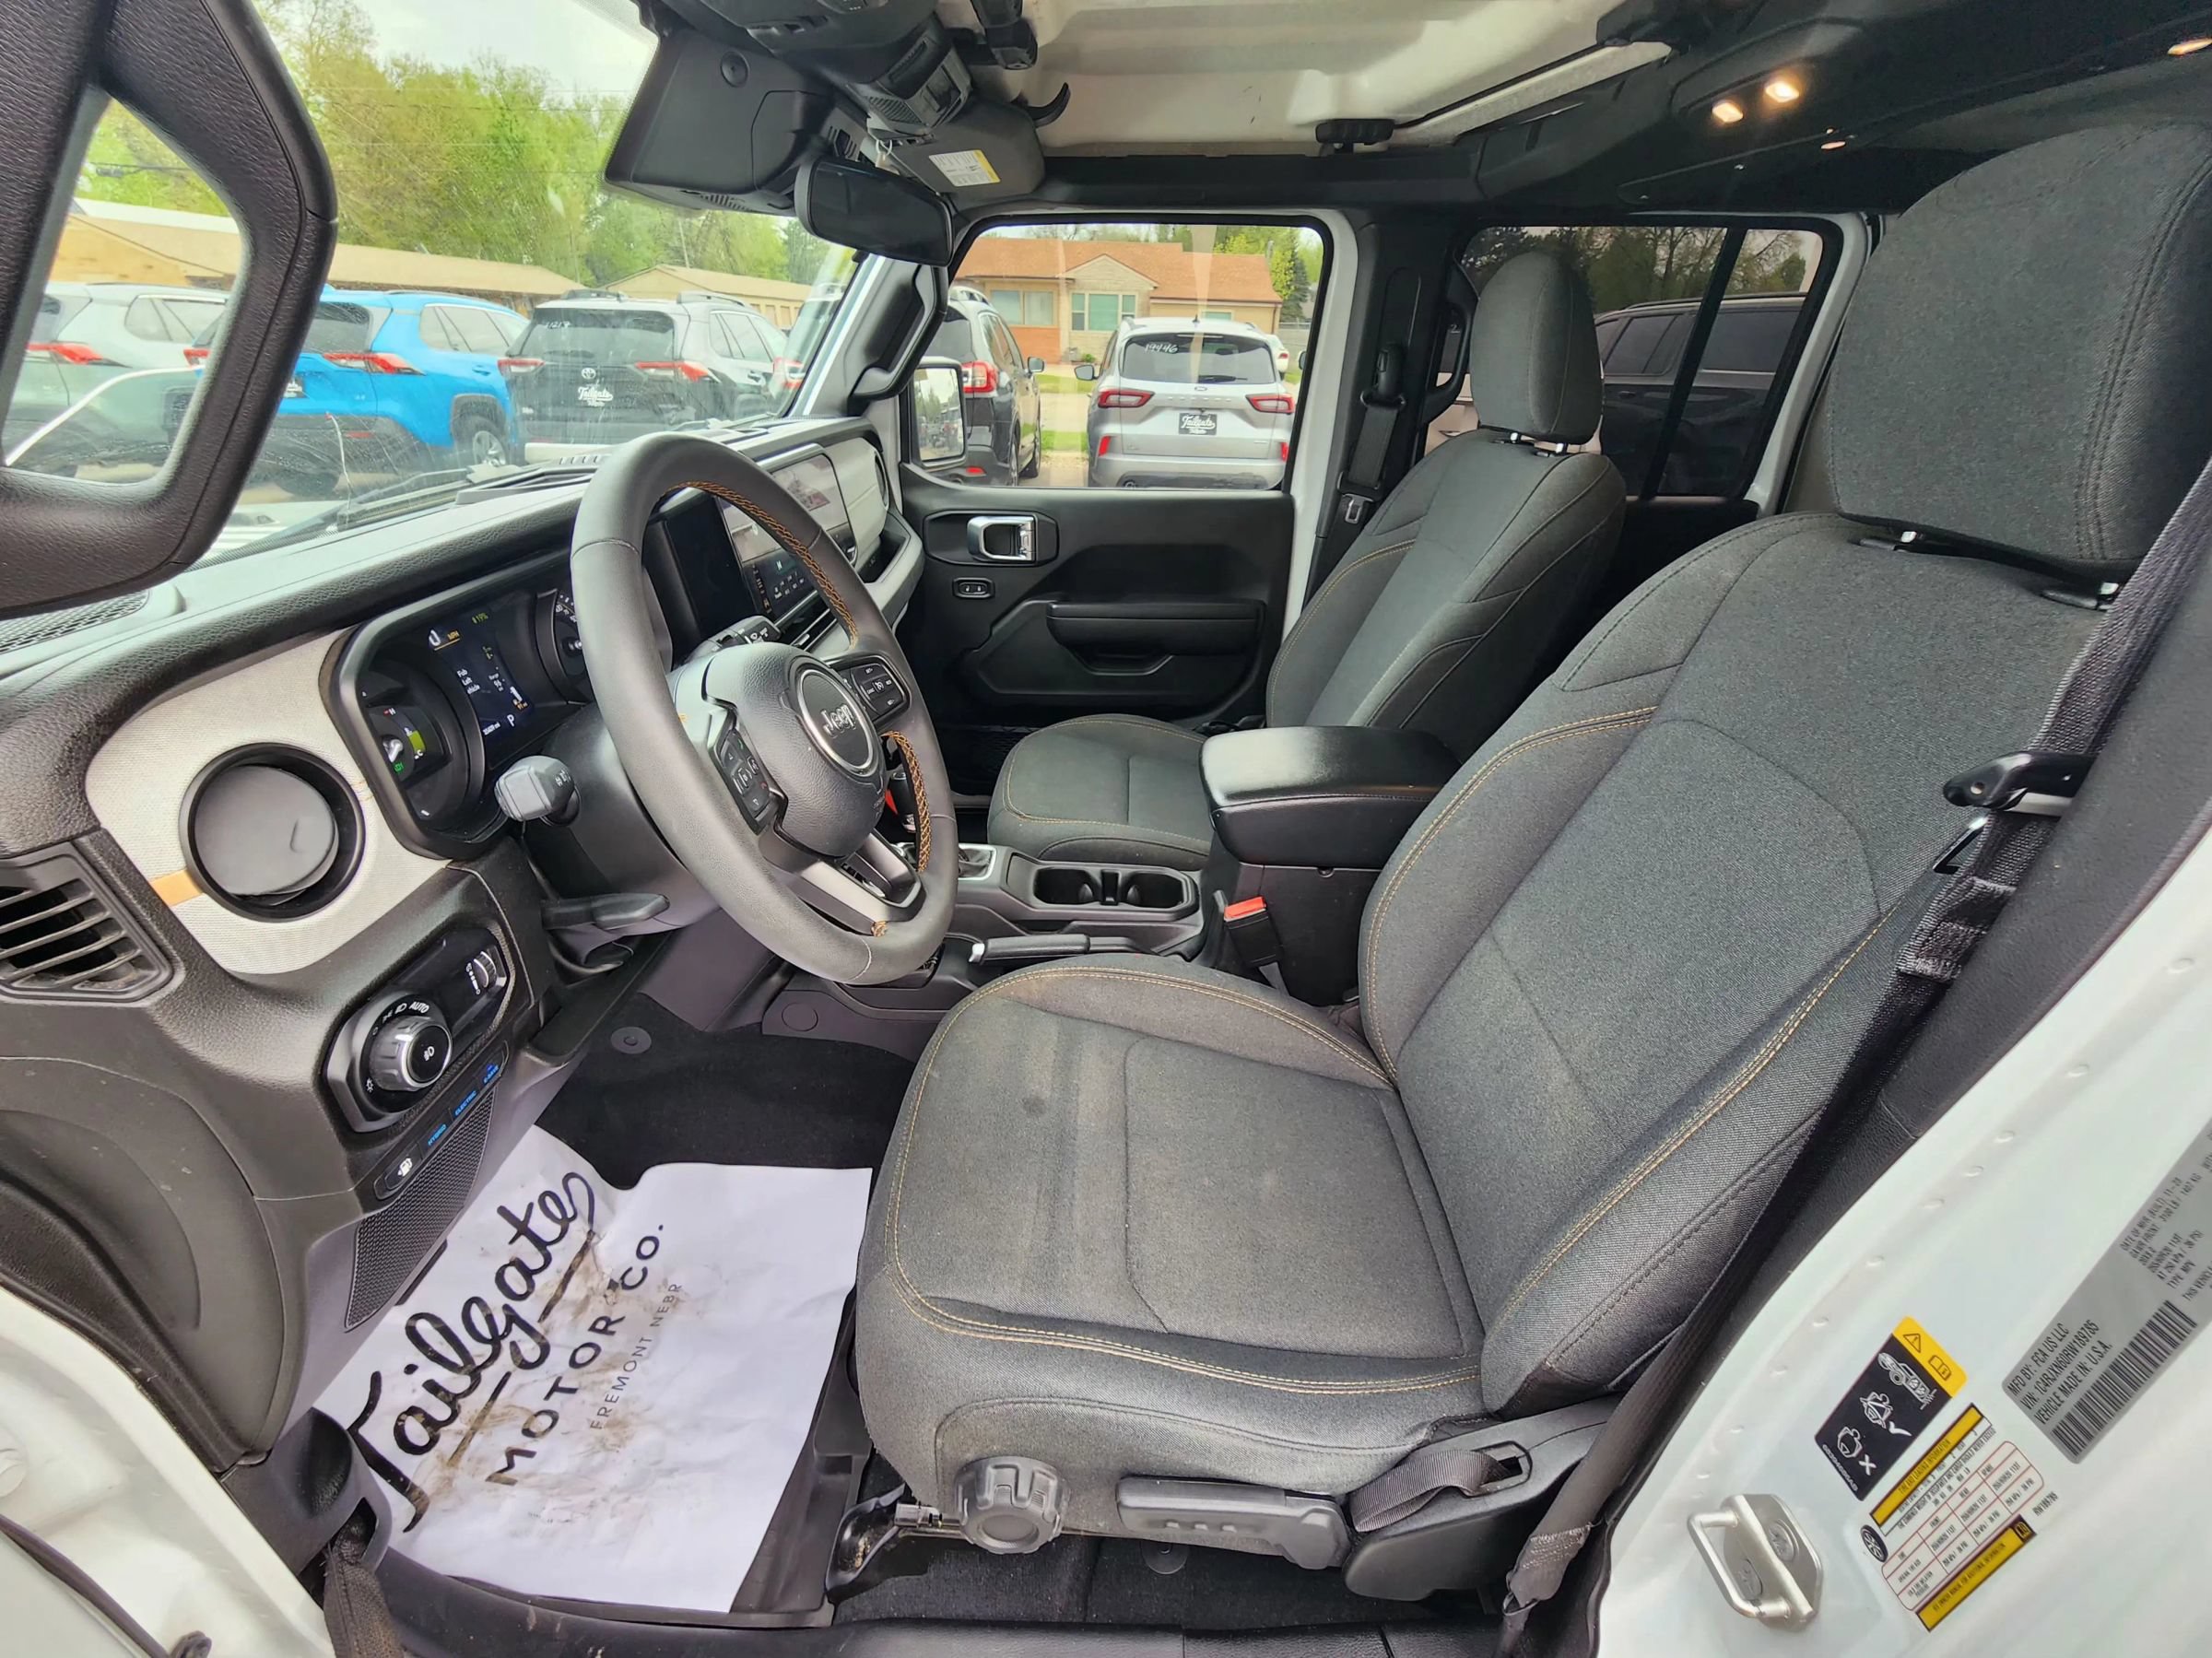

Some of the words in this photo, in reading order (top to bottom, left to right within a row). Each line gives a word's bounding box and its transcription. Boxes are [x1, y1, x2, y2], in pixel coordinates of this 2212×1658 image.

[507, 714, 515, 727] P
[820, 704, 857, 737] Jeep
[408, 1001, 429, 1014] AUTO
[455, 1090, 477, 1116] ELECTRIC
[428, 1123, 447, 1146] HYBRID
[486, 1314, 626, 1487] MOTOR
[620, 1224, 664, 1290] CO.
[590, 1336, 653, 1430] FREMONT
[650, 1284, 682, 1327] NEBR
[2006, 1374, 2027, 1396] MFD
[2018, 1361, 2037, 1381] BY:
[2029, 1346, 2049, 1368] FCA
[2041, 1335, 2058, 1353] US
[2050, 1321, 2069, 1342] LLC
[2033, 1390, 2065, 1425] VEHICLE
[2056, 1370, 2083, 1398] MADE
[2074, 1358, 2092, 1378] IN:
[2084, 1335, 2112, 1366] U.S.A.
[2019, 1389, 2040, 1410] VIN:
